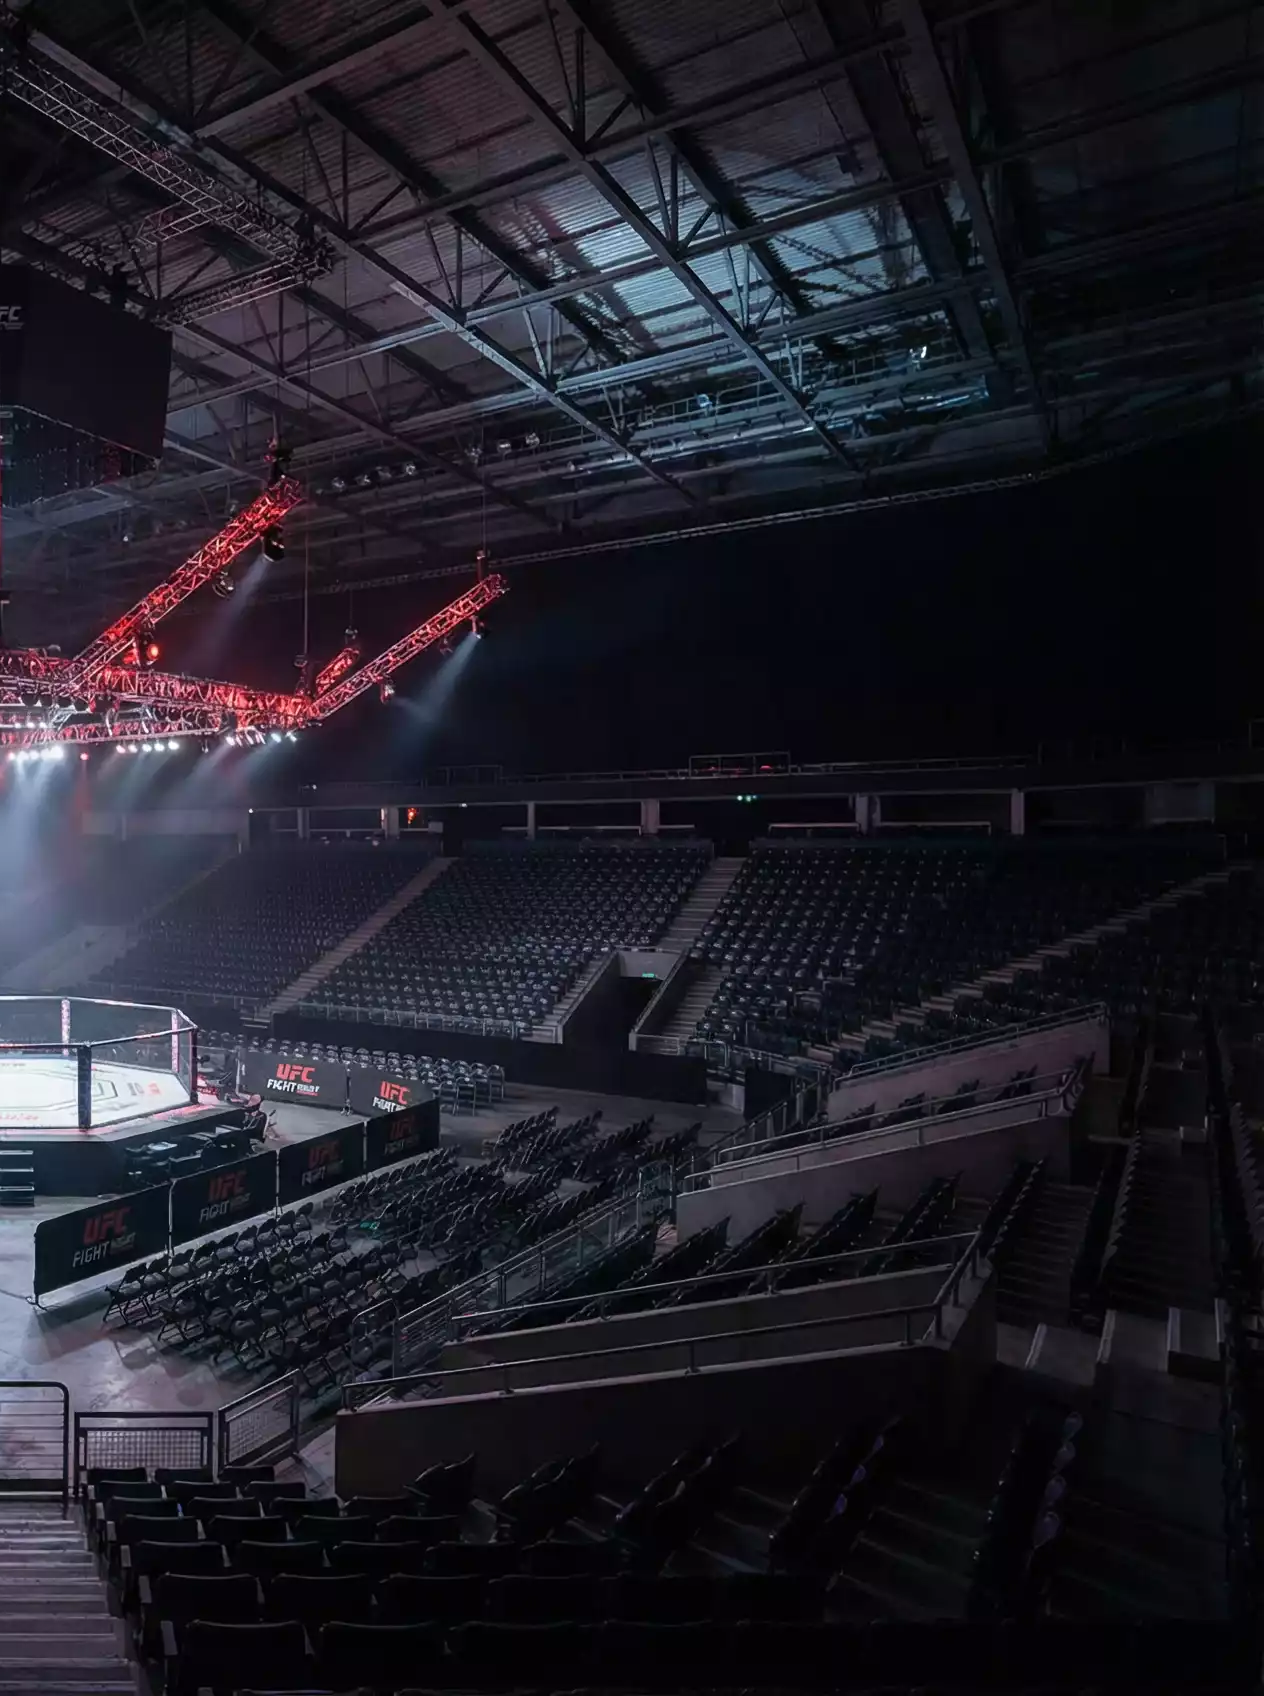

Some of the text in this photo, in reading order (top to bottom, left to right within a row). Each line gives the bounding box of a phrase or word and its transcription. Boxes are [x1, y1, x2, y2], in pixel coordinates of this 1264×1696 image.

[276, 1063, 316, 1084] UFC
[379, 1080, 411, 1105] UFC
[82, 1206, 133, 1247] UFC
[72, 1240, 111, 1268] FIGHT
